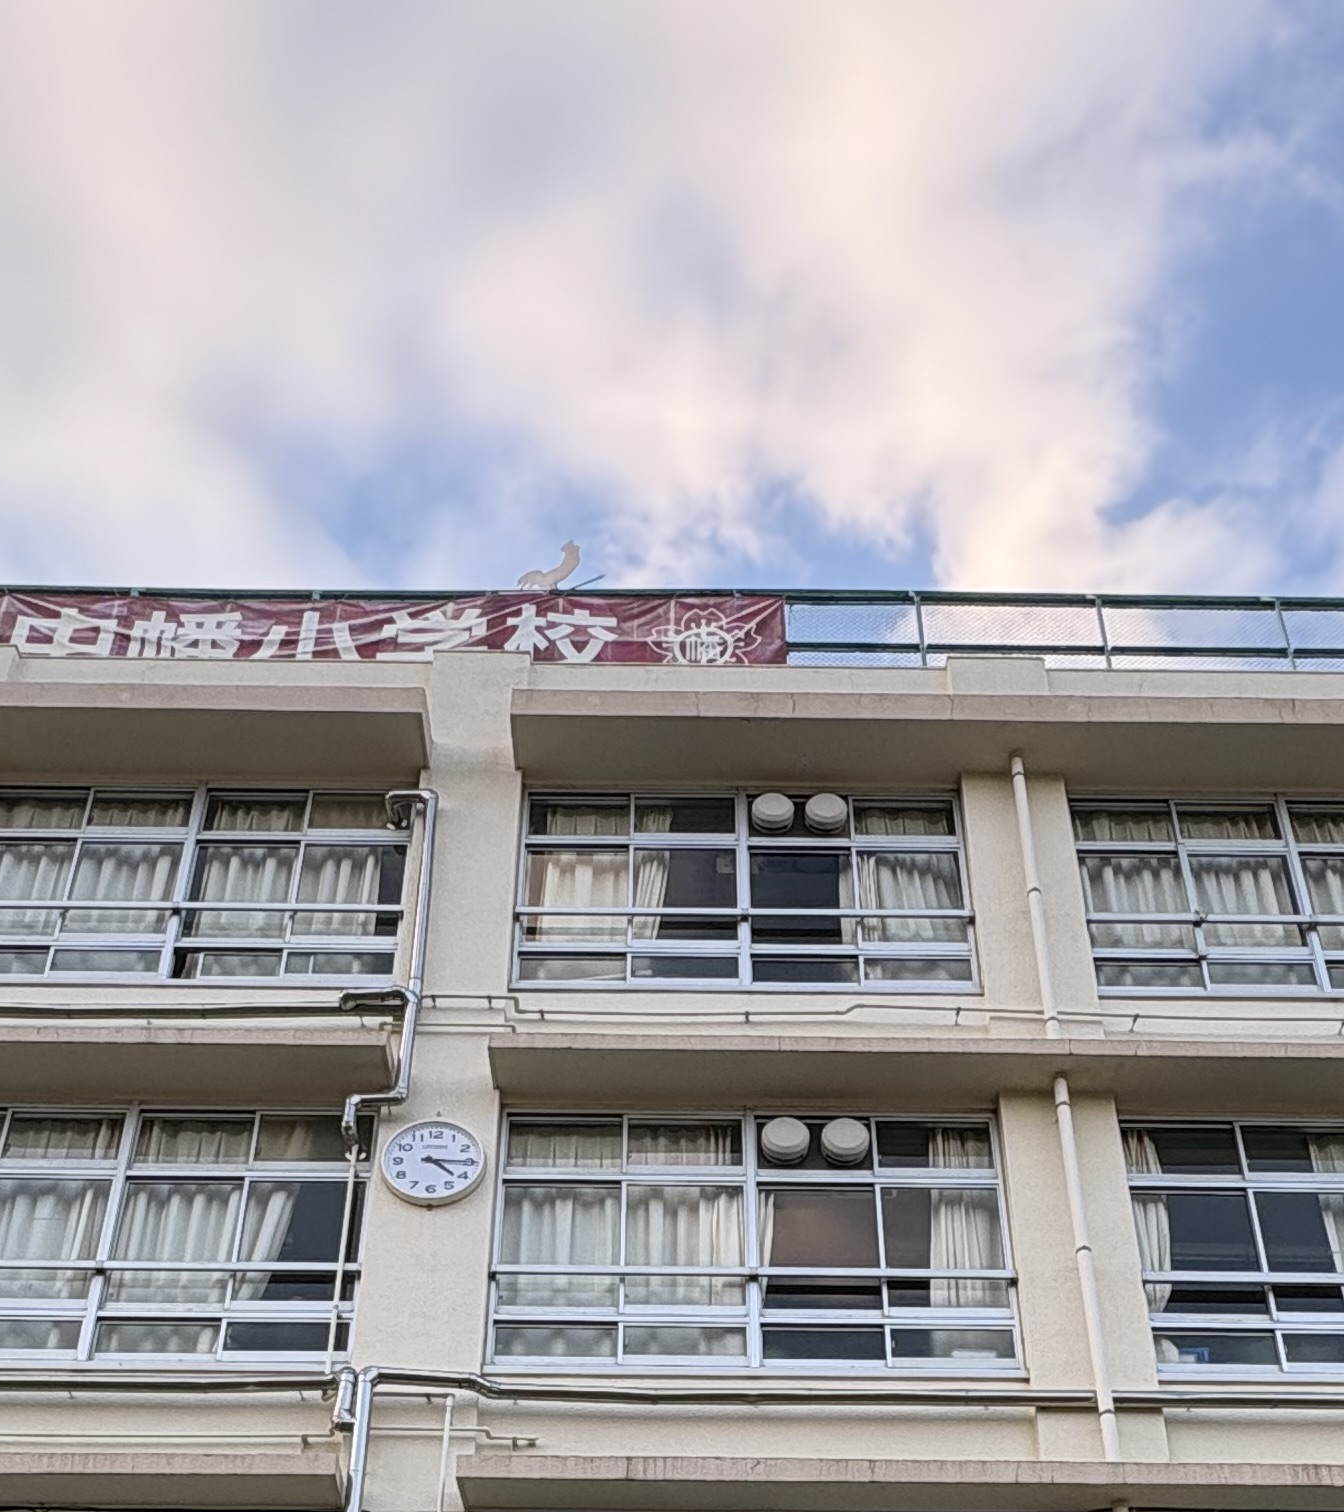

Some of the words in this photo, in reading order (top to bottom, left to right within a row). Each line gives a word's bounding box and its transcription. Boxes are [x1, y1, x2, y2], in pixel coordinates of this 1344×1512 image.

[412, 1133, 423, 1142] 11
[429, 1131, 443, 1139] 12
[399, 1143, 413, 1152] 10
[460, 1144, 471, 1152] 2
[393, 1157, 403, 1165] 9
[396, 1171, 406, 1179] 8
[457, 1171, 468, 1180] 4
[409, 1181, 419, 1189] 7
[425, 1185, 436, 1193] 6
[444, 1181, 454, 1190] 5
